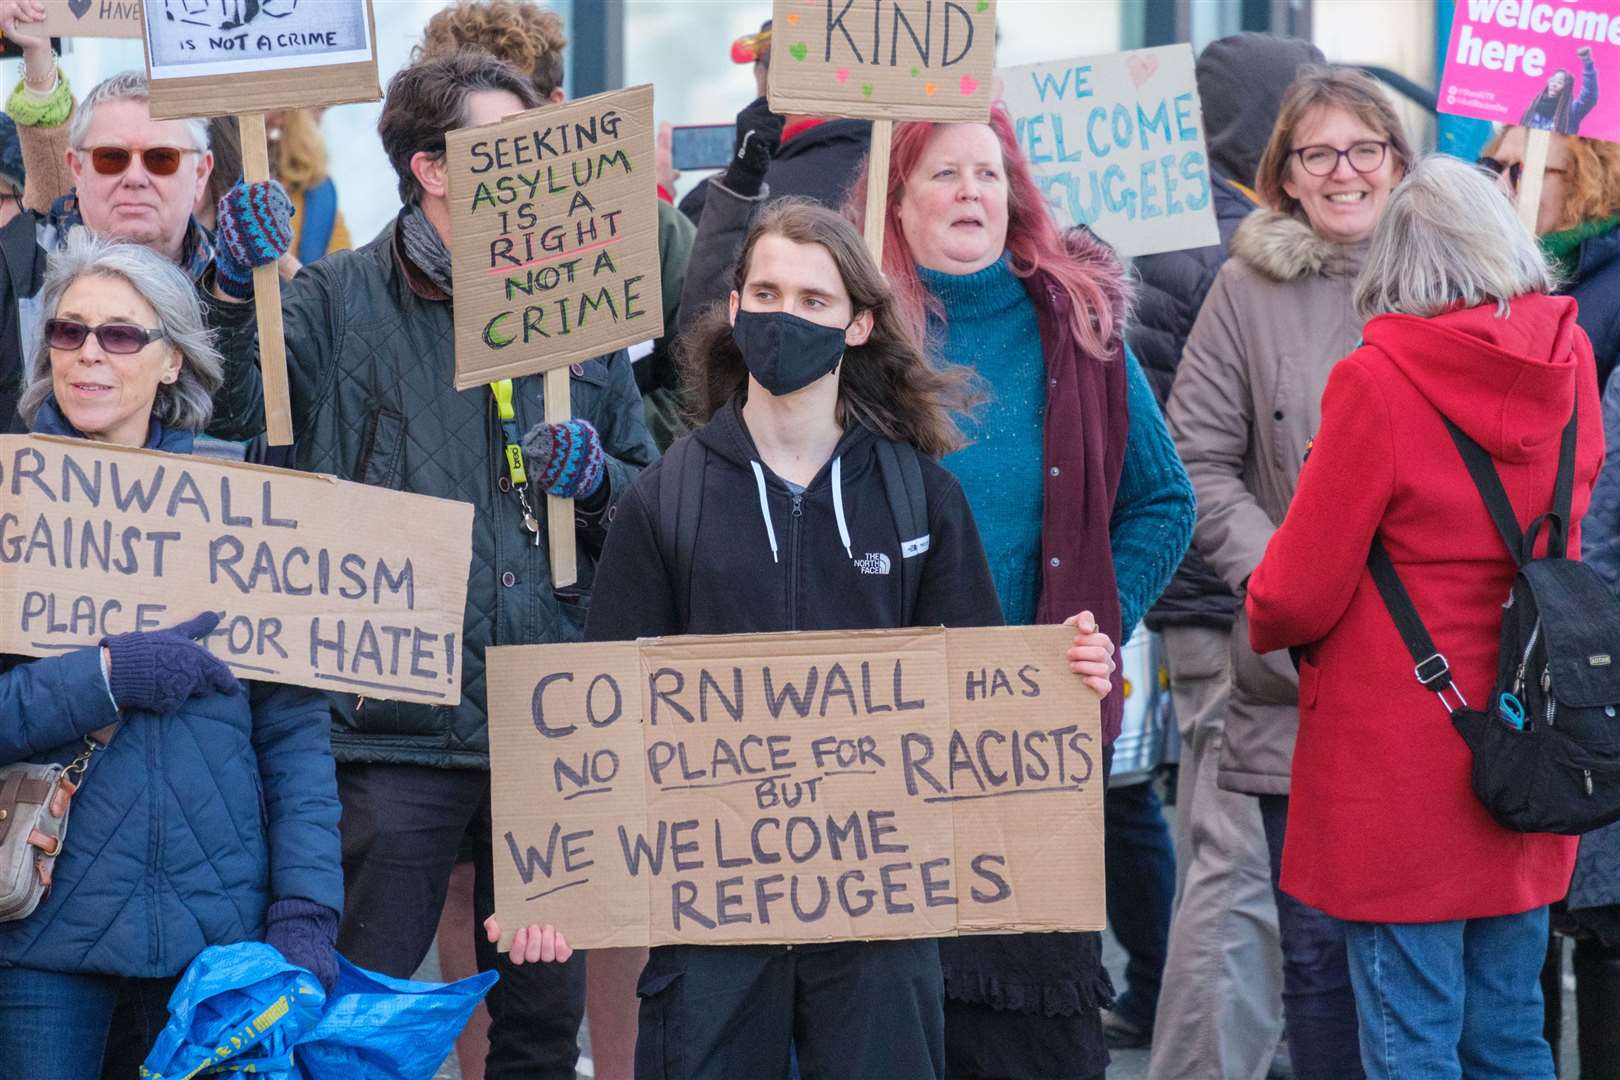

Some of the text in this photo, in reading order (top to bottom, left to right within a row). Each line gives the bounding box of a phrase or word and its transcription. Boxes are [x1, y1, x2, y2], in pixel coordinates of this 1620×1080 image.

[99, 0, 140, 20] HAVE
[209, 34, 248, 50] NOT
[257, 36, 271, 50] A
[277, 32, 337, 47] CRIME
[825, 0, 974, 67] KIND
[1456, 25, 1546, 77] here
[1032, 65, 1093, 102] WE
[470, 111, 622, 173] SEEKING
[471, 150, 632, 214] ASYLUM
[498, 191, 596, 235] IS A
[490, 210, 622, 267] RIGHT
[505, 249, 617, 300] NOT A
[482, 275, 646, 350] CRIME
[0, 447, 298, 529] RNWALL
[209, 534, 415, 610] RACISM
[310, 617, 456, 684] HATE!
[531, 659, 1041, 737] CORNWALL HAS
[553, 724, 1093, 796] NO PLACE FOR RACISTS
[755, 776, 823, 809] BUT
[504, 809, 909, 884] WE WELCOME
[672, 854, 1012, 931] REFUGEES
